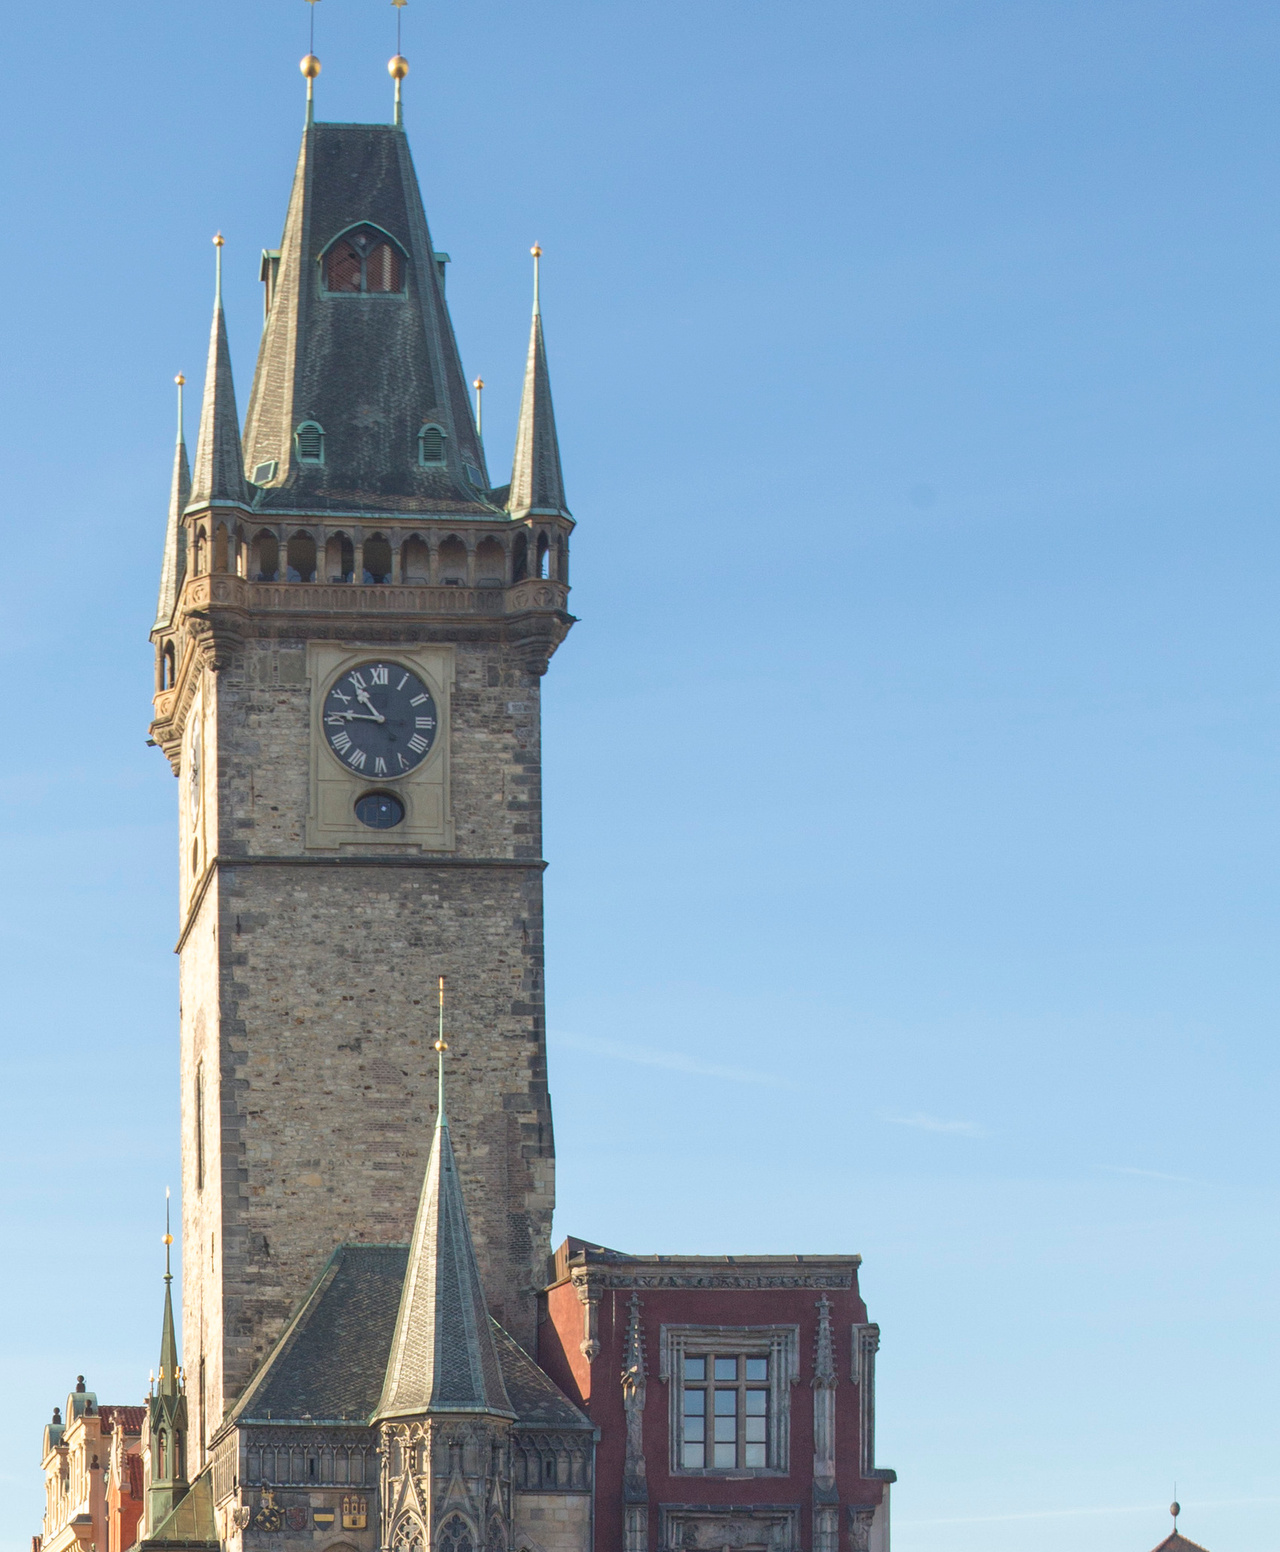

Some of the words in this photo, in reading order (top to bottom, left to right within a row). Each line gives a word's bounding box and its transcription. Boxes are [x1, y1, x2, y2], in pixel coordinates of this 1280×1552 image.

[370, 667, 389, 685] XII
[396, 675, 408, 691] I
[333, 689, 351, 705] X
[409, 693, 427, 707] II
[415, 716, 432, 729] III
